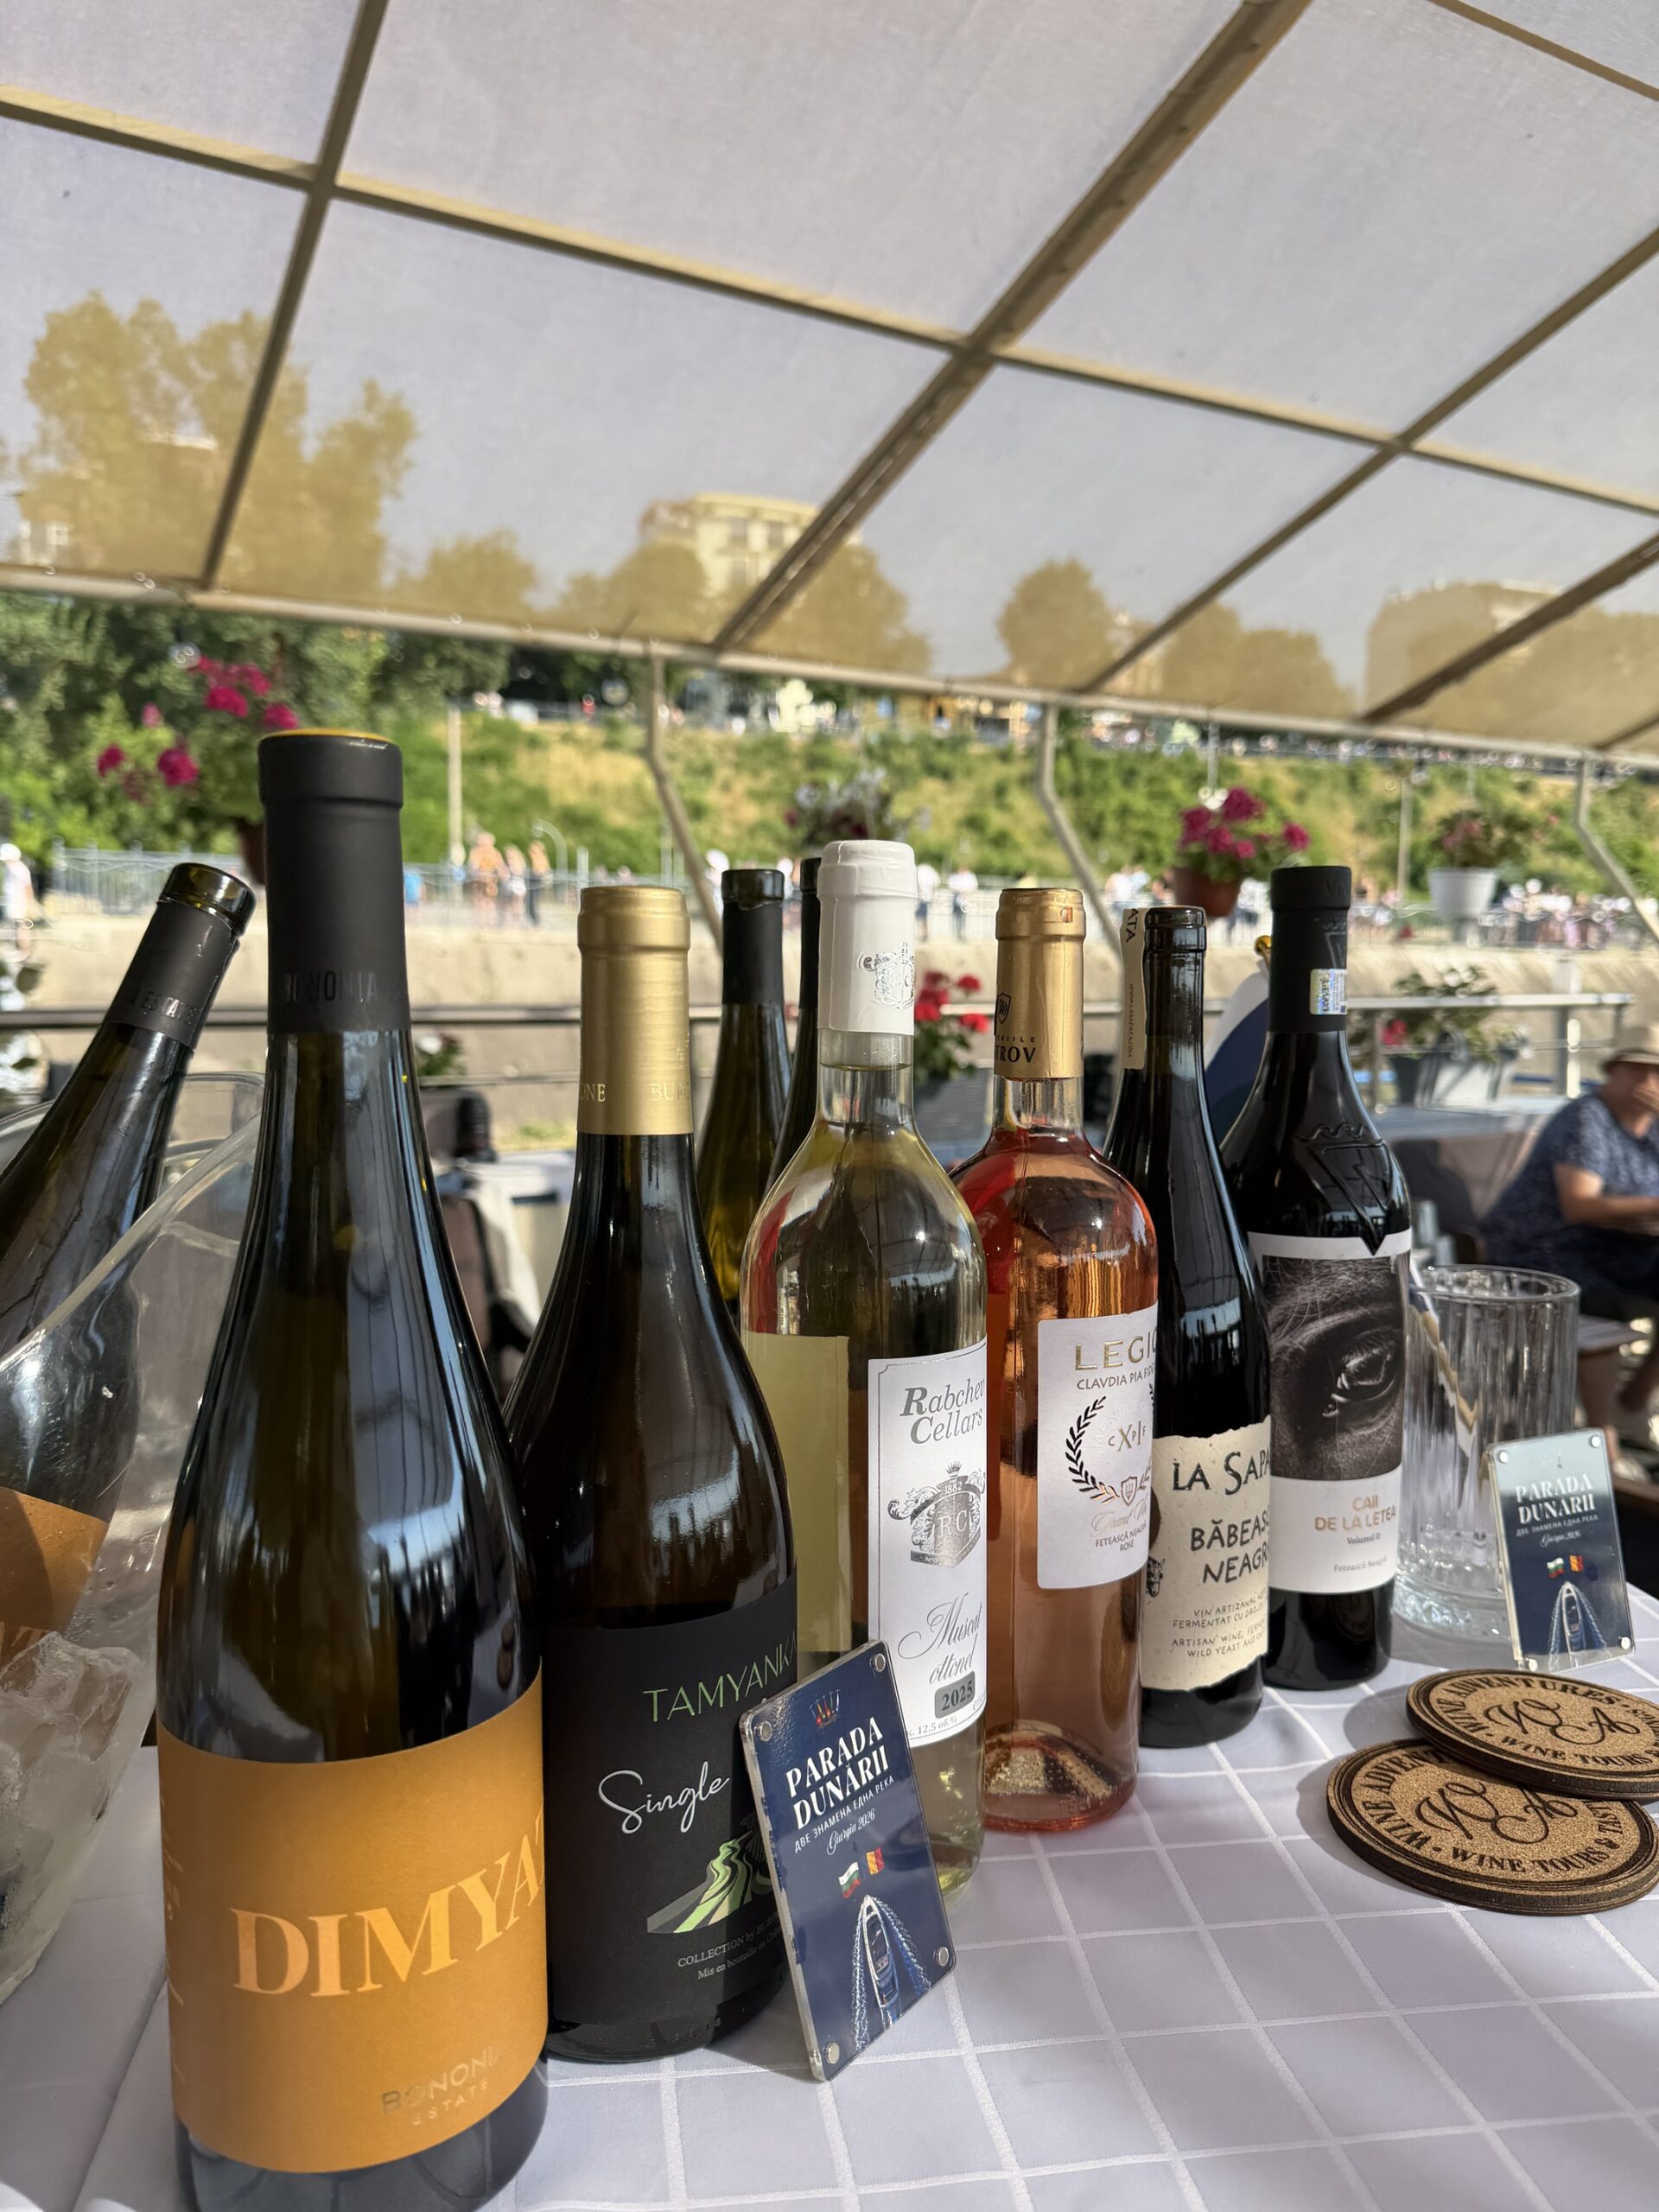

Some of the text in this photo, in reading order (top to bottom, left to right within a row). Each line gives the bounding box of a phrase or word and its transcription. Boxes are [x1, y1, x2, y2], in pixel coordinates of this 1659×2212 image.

[1077, 1375, 1128, 1389] CLAVDIA
[1129, 1371, 1142, 1383] PIA
[910, 1408, 983, 1445] Cellars
[1172, 1460, 1211, 1491] LA
[1515, 1472, 1593, 1503] PARADA
[1314, 1505, 1396, 1531] DE LA LETEA
[898, 1592, 983, 1660] Muscat
[1173, 1616, 1232, 1629] FERMENTAT
[1186, 1648, 1212, 1657] WILD
[1215, 1643, 1241, 1656] YEAST
[941, 1680, 974, 1712] 2025
[1442, 1675, 1621, 1706] ADVENTURES
[785, 1716, 883, 1798] PARADA
[1502, 1735, 1567, 1760] WINE
[1574, 1753, 1653, 1768] TOURS
[793, 1745, 889, 1830] DUNĂRII
[1360, 1748, 1446, 1796] ADVENT
[598, 1760, 731, 1834] Single
[794, 1775, 894, 1853] ДВЕ ЗНАМЕНА ЕДНА РЕКА
[1451, 1846, 1526, 1872] WINE
[1532, 1847, 1610, 1873] TOURS
[677, 1937, 745, 1967] COLLECTION
[697, 1967, 715, 1980] Mis
[716, 1963, 726, 1973] en
